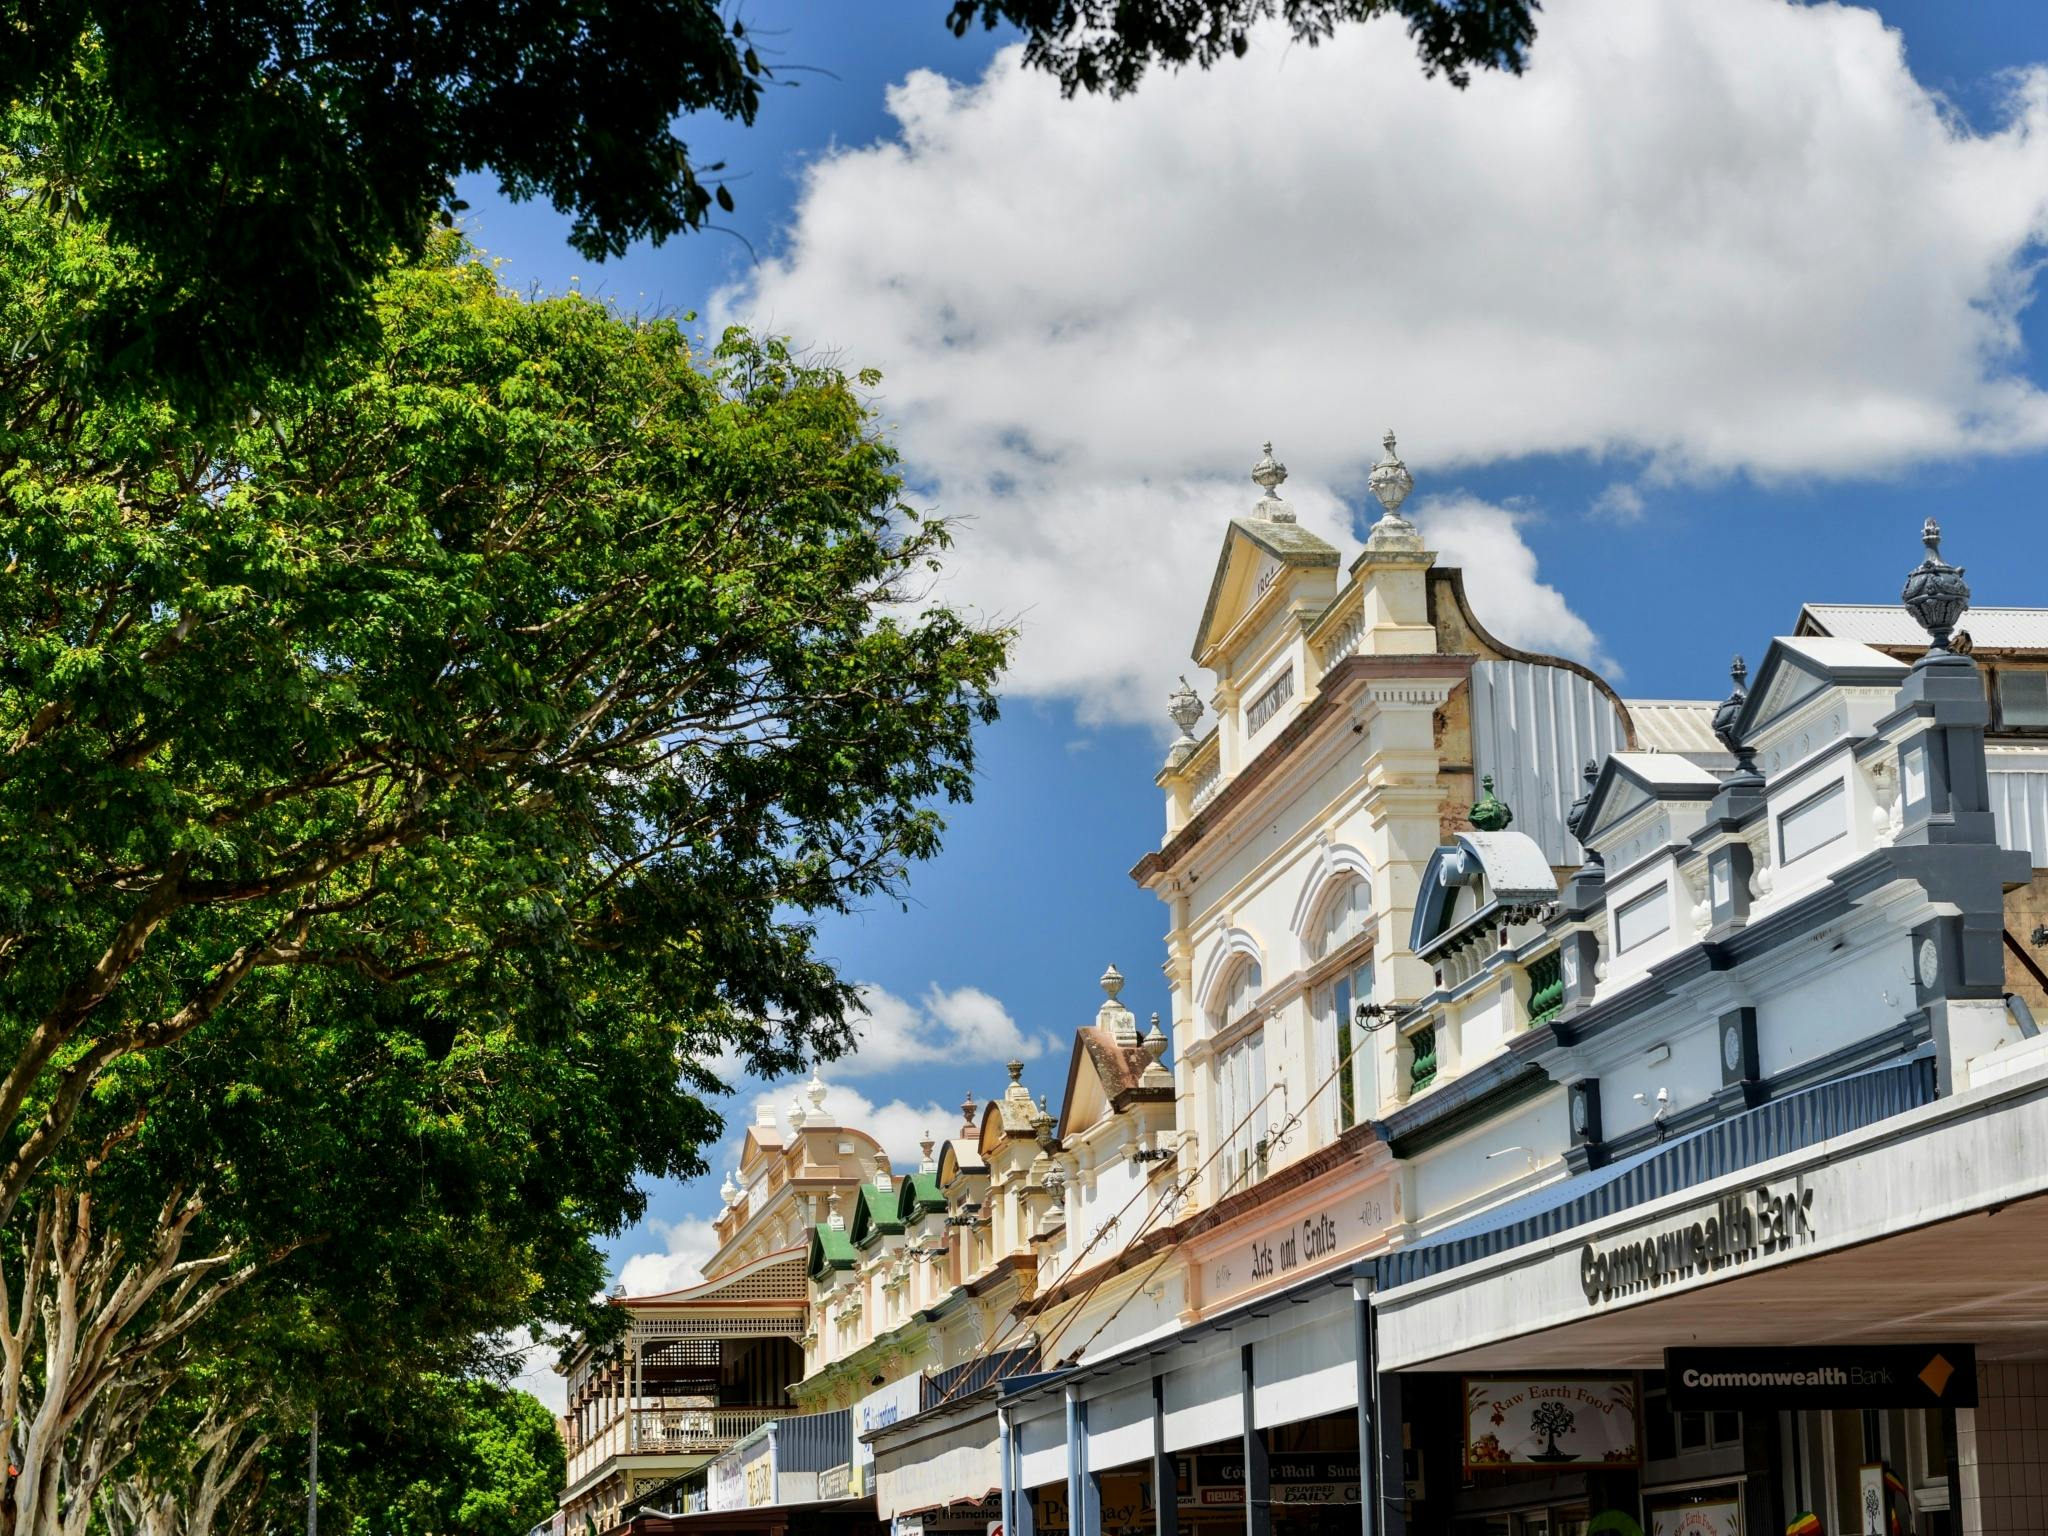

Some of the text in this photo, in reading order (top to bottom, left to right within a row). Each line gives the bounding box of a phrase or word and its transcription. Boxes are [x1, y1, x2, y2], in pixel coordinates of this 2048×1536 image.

[1580, 1175, 1815, 1300] Commonwealth Bank
[1251, 1210, 1337, 1285] Arts and Crafts
[1682, 1366, 1895, 1388] Commonwealth Bank
[1491, 1385, 1617, 1416] Raw Earth Food
[1221, 1464, 1315, 1480] Cour-Mail
[1284, 1492, 1335, 1502] DAILY
[1285, 1485, 1335, 1493] DELIVERED
[942, 1508, 1003, 1519] firstnation
[1042, 1497, 1136, 1526] Phacy
[1685, 1510, 1702, 1527] Earth
